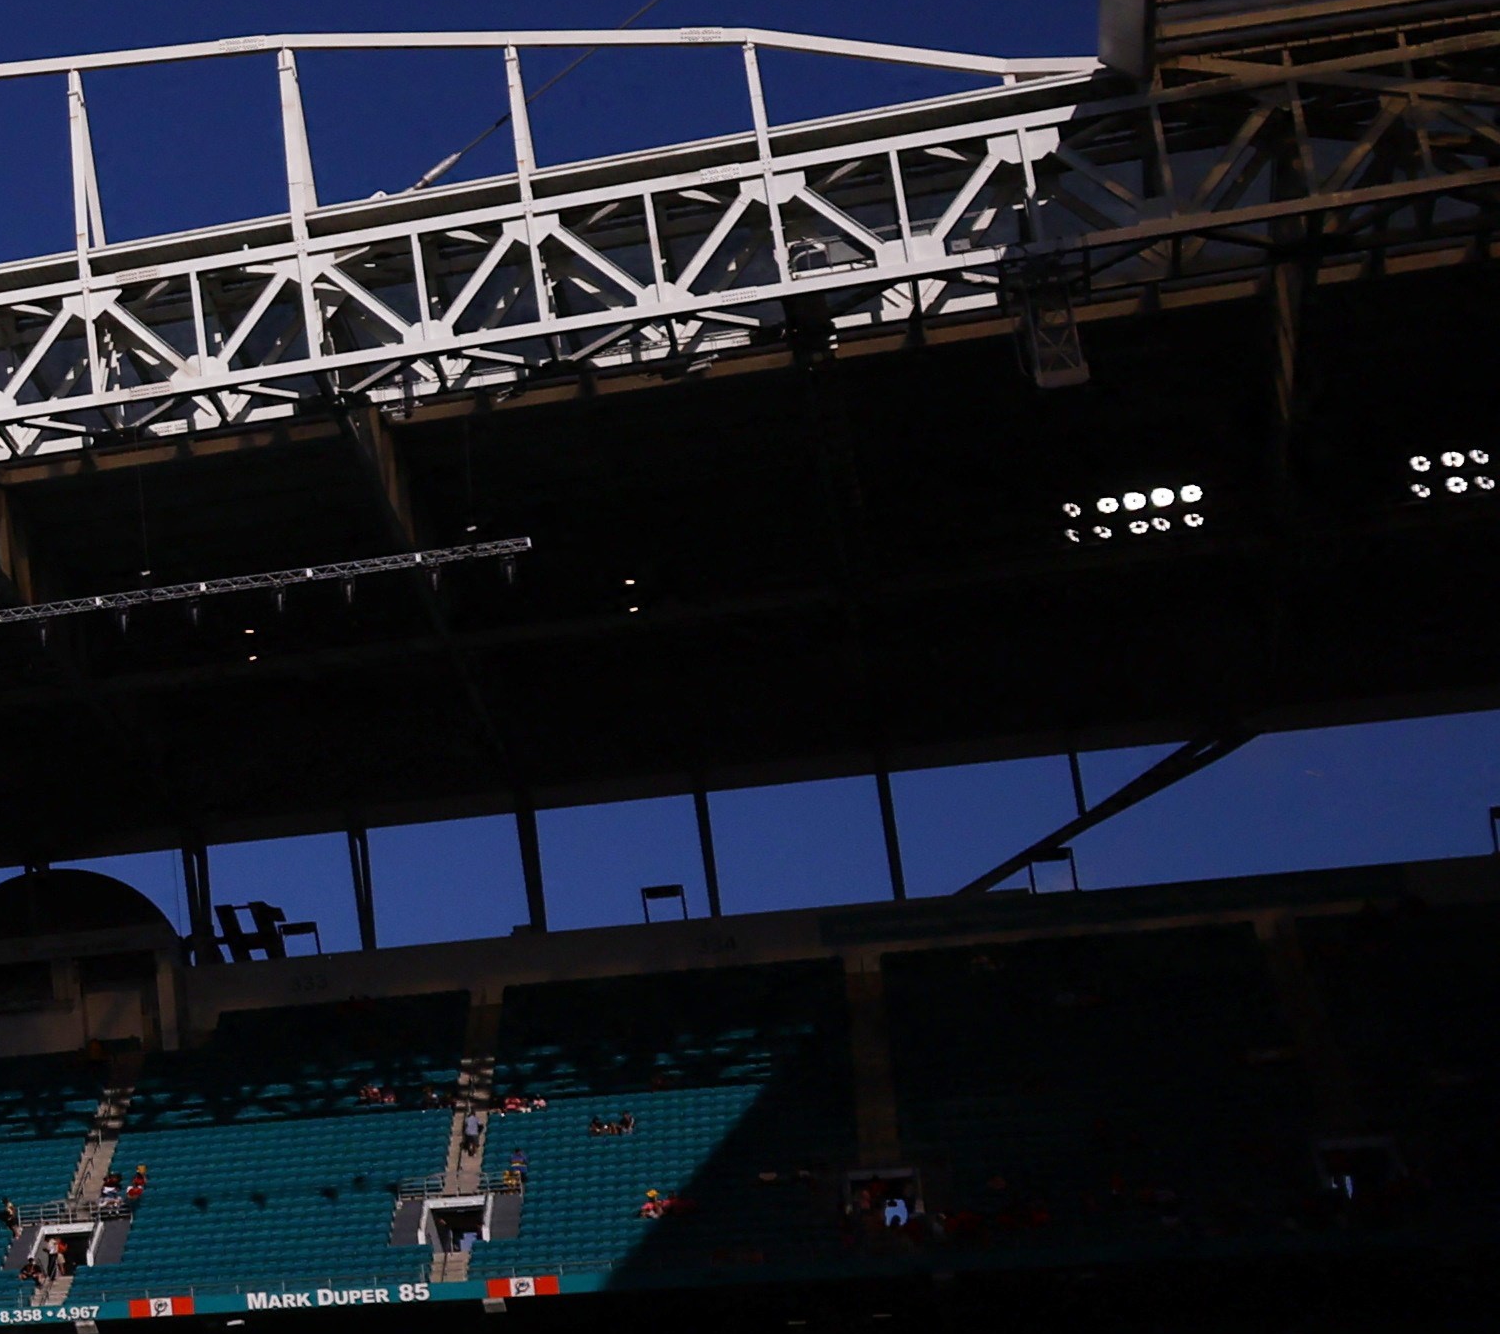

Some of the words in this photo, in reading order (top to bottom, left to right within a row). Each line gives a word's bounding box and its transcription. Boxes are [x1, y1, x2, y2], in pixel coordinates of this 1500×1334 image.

[247, 1291, 311, 1311] MARK
[316, 1287, 390, 1308] DUPER
[398, 1282, 430, 1302] 85
